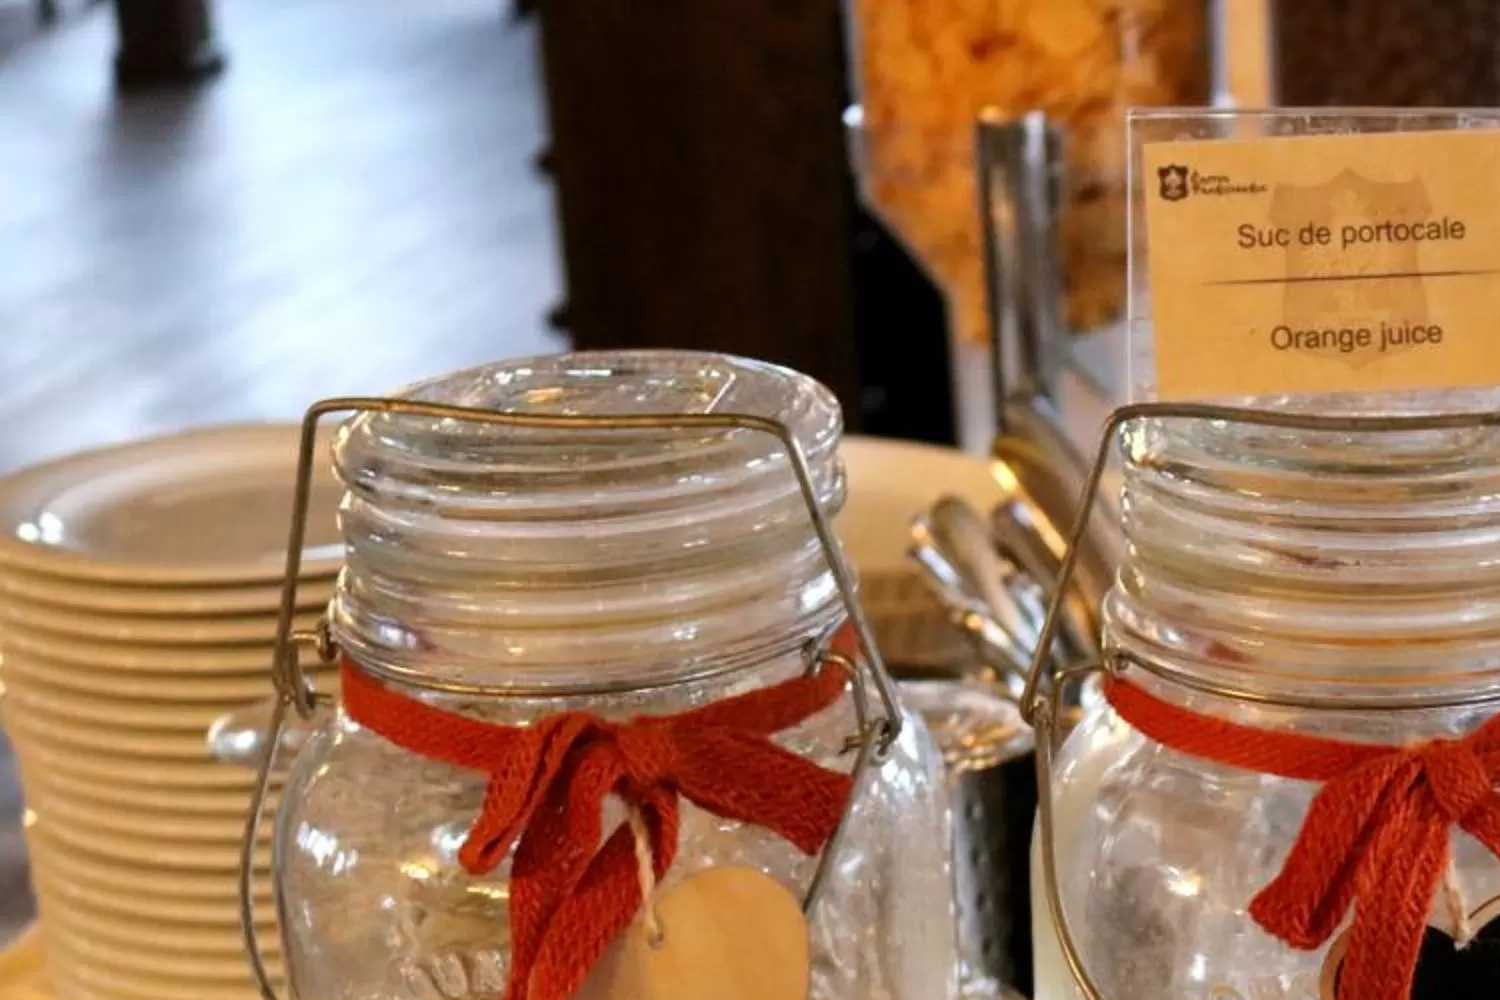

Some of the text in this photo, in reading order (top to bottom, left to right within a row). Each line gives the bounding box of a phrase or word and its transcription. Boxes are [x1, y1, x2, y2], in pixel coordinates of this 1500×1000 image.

[1237, 215, 1467, 251] Suc de portocale
[1270, 321, 1444, 354] Orange juice
